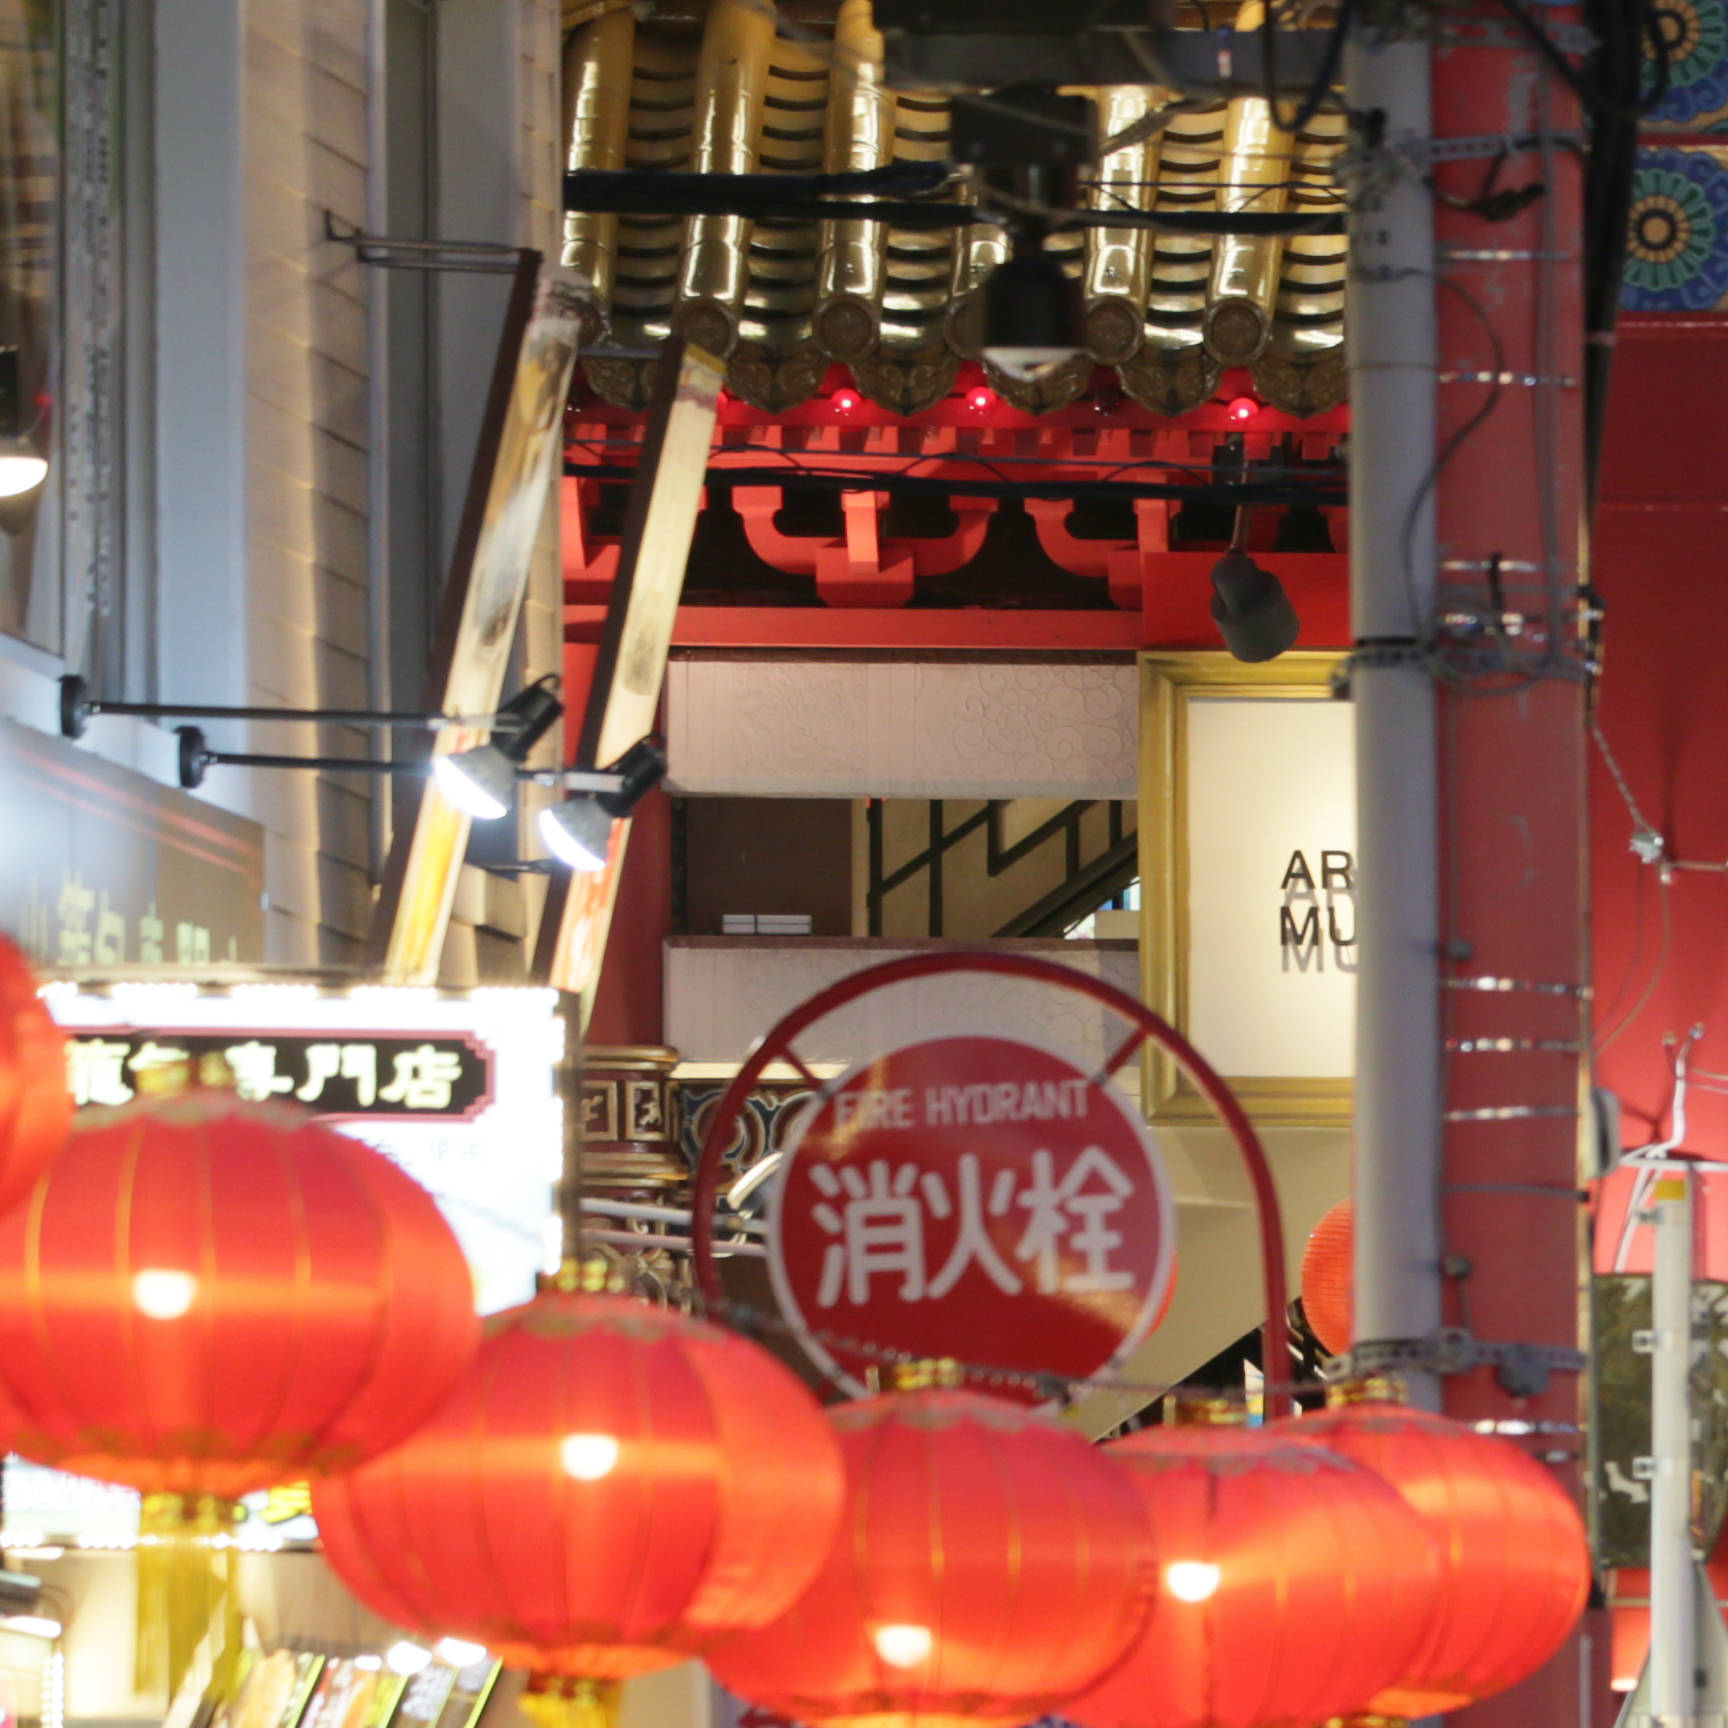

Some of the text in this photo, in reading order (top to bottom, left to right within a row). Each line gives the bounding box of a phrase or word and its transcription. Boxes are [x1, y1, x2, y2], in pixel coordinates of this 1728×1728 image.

[833, 1077, 1089, 1130] FIRE HYDRANT
[808, 1145, 1136, 1308] 消火栓
